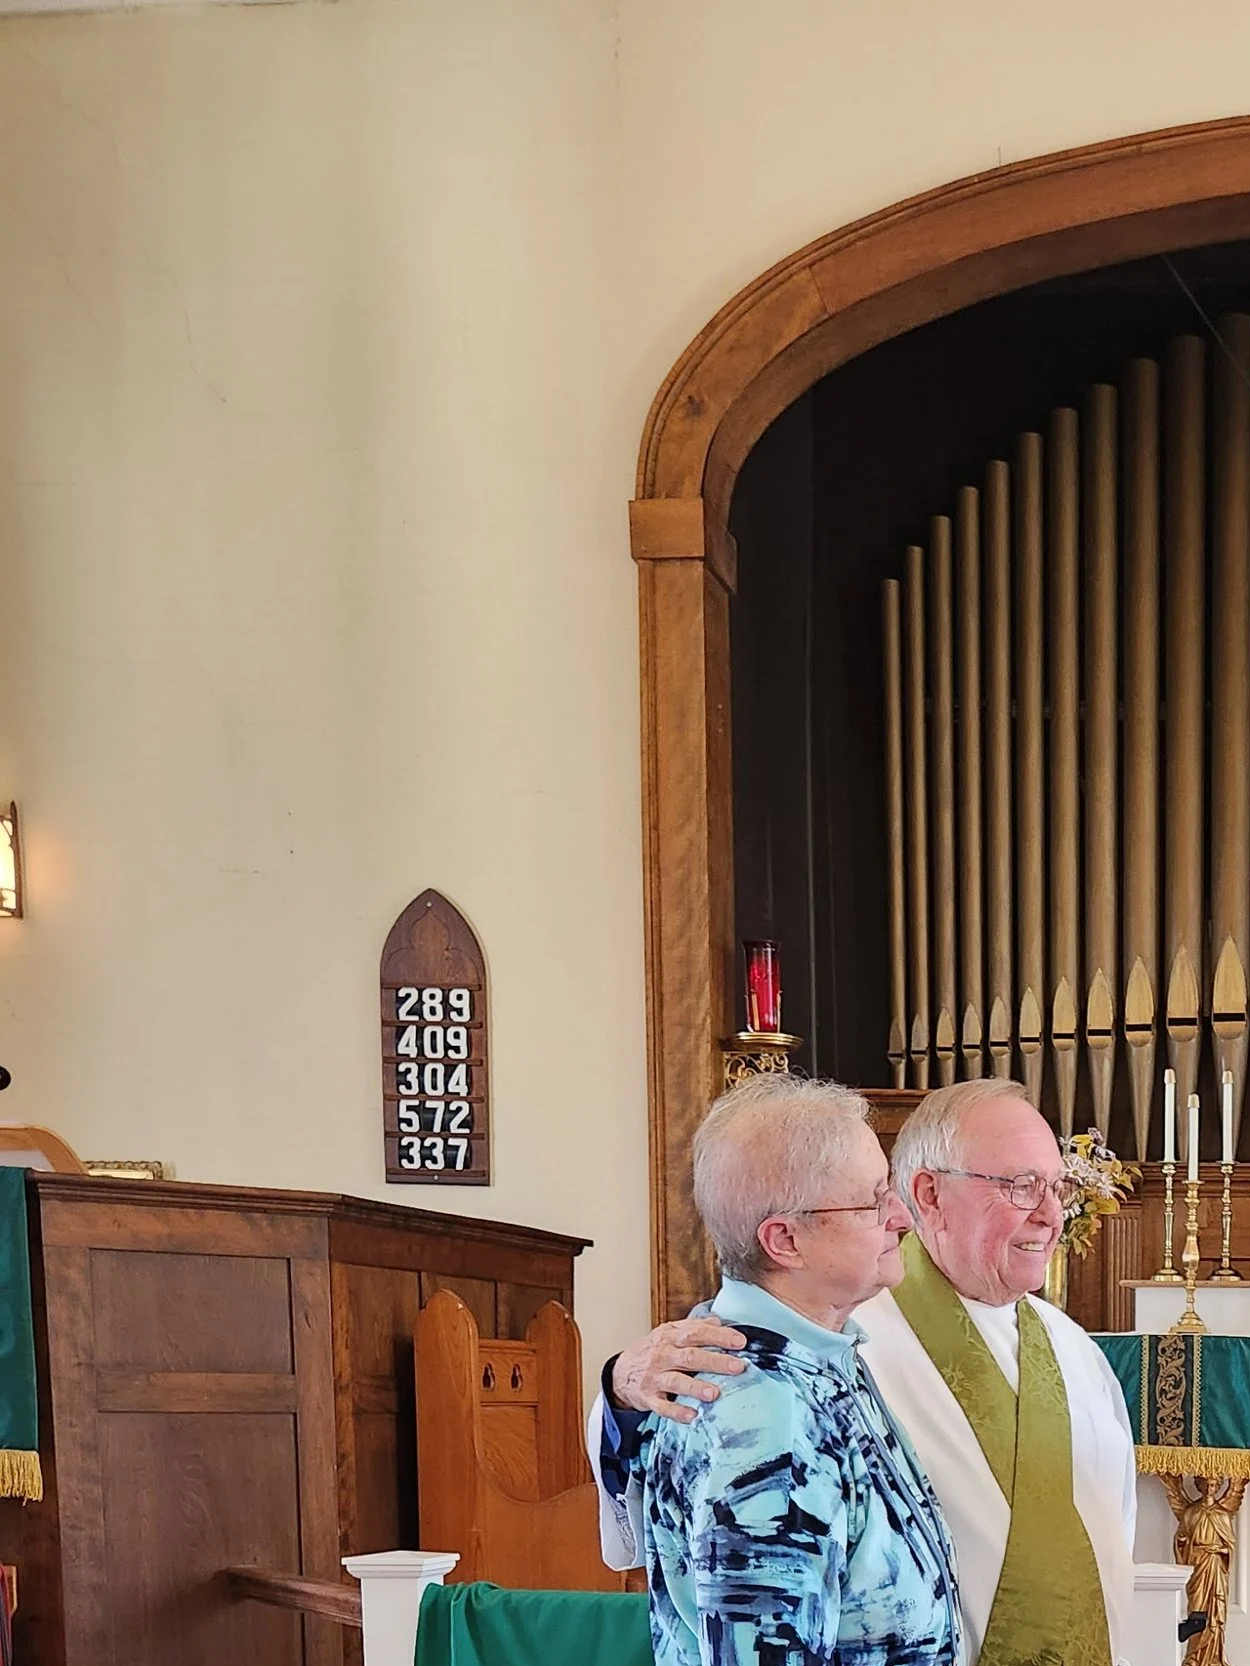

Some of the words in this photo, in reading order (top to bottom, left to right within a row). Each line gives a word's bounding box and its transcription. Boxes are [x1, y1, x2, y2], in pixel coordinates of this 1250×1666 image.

[398, 987, 470, 1022] 289
[398, 1026, 467, 1059] 409
[399, 1063, 468, 1096] 304
[399, 1100, 469, 1133] 572
[401, 1137, 467, 1170] 337
